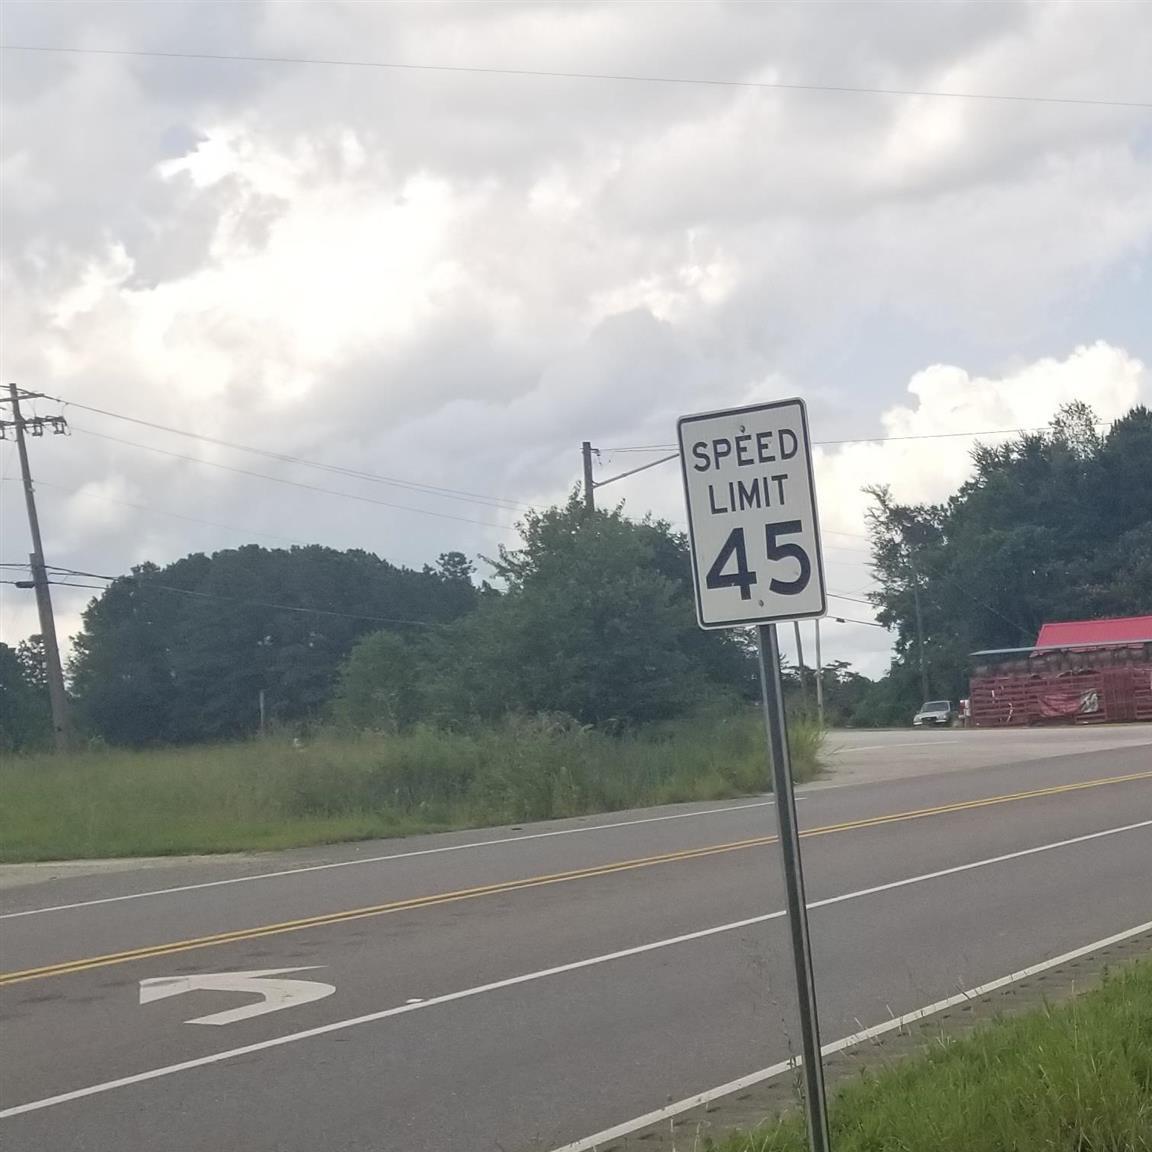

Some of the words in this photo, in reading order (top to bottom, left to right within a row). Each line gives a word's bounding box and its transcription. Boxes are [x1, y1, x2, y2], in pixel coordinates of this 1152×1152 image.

[692, 428, 798, 472] SPEED
[708, 474, 788, 515] LIMIT
[706, 519, 811, 600] 45
